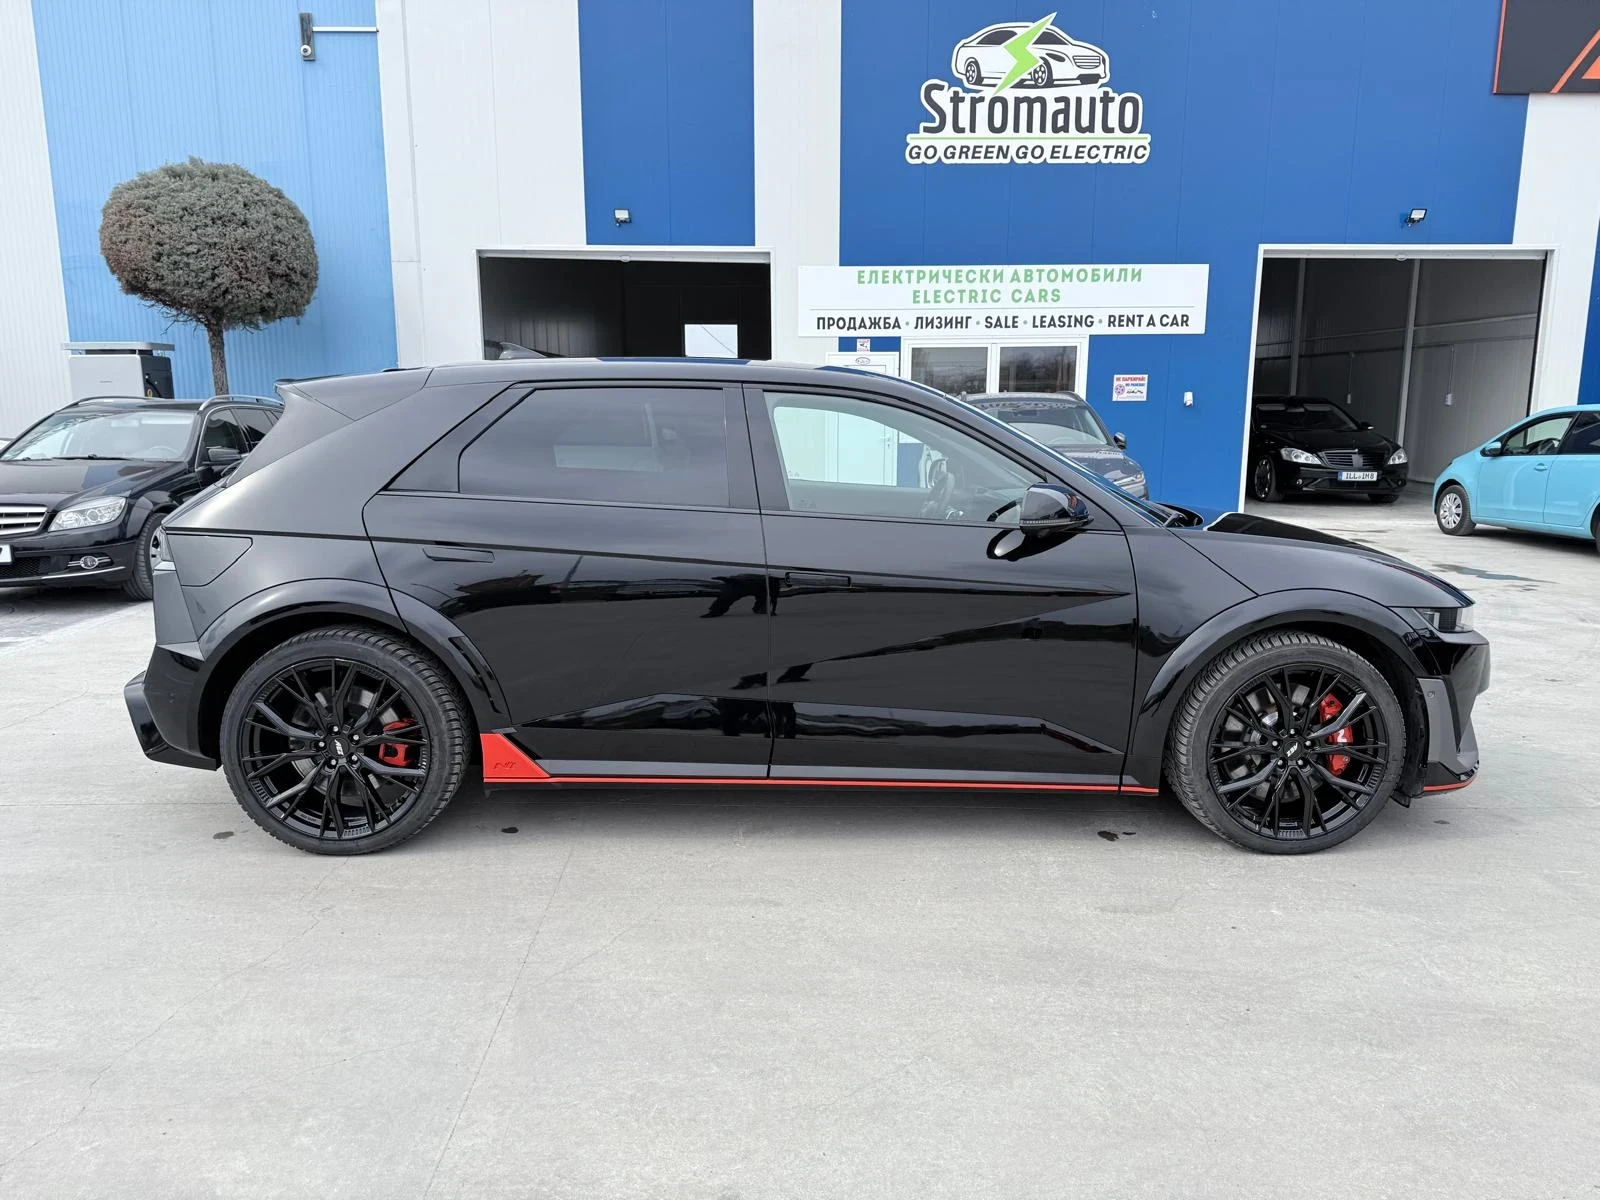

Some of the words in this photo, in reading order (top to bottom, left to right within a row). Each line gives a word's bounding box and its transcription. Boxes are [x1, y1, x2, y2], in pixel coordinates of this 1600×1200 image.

[923, 83, 1140, 134] Stromauto
[908, 145, 938, 160] GO
[943, 145, 1010, 160] GREEN
[1015, 145, 1045, 160] GO
[1050, 145, 1148, 160] ELECTRIC
[857, 269, 1004, 285] ЕЛЕКТРИЧЕСКИ
[1010, 268, 1142, 284] АВТОМОБИЛИ
[912, 289, 1001, 304] ELECTRIC
[1011, 288, 1061, 303] CARS
[816, 316, 902, 332] ПРОДАЖБА
[914, 316, 972, 330] ЛИЗИНГ
[984, 315, 1019, 329] SALE
[1031, 315, 1095, 329] LEASING
[1107, 314, 1145, 328] RENT
[1146, 314, 1157, 328] A
[1159, 314, 1190, 328] CAR
